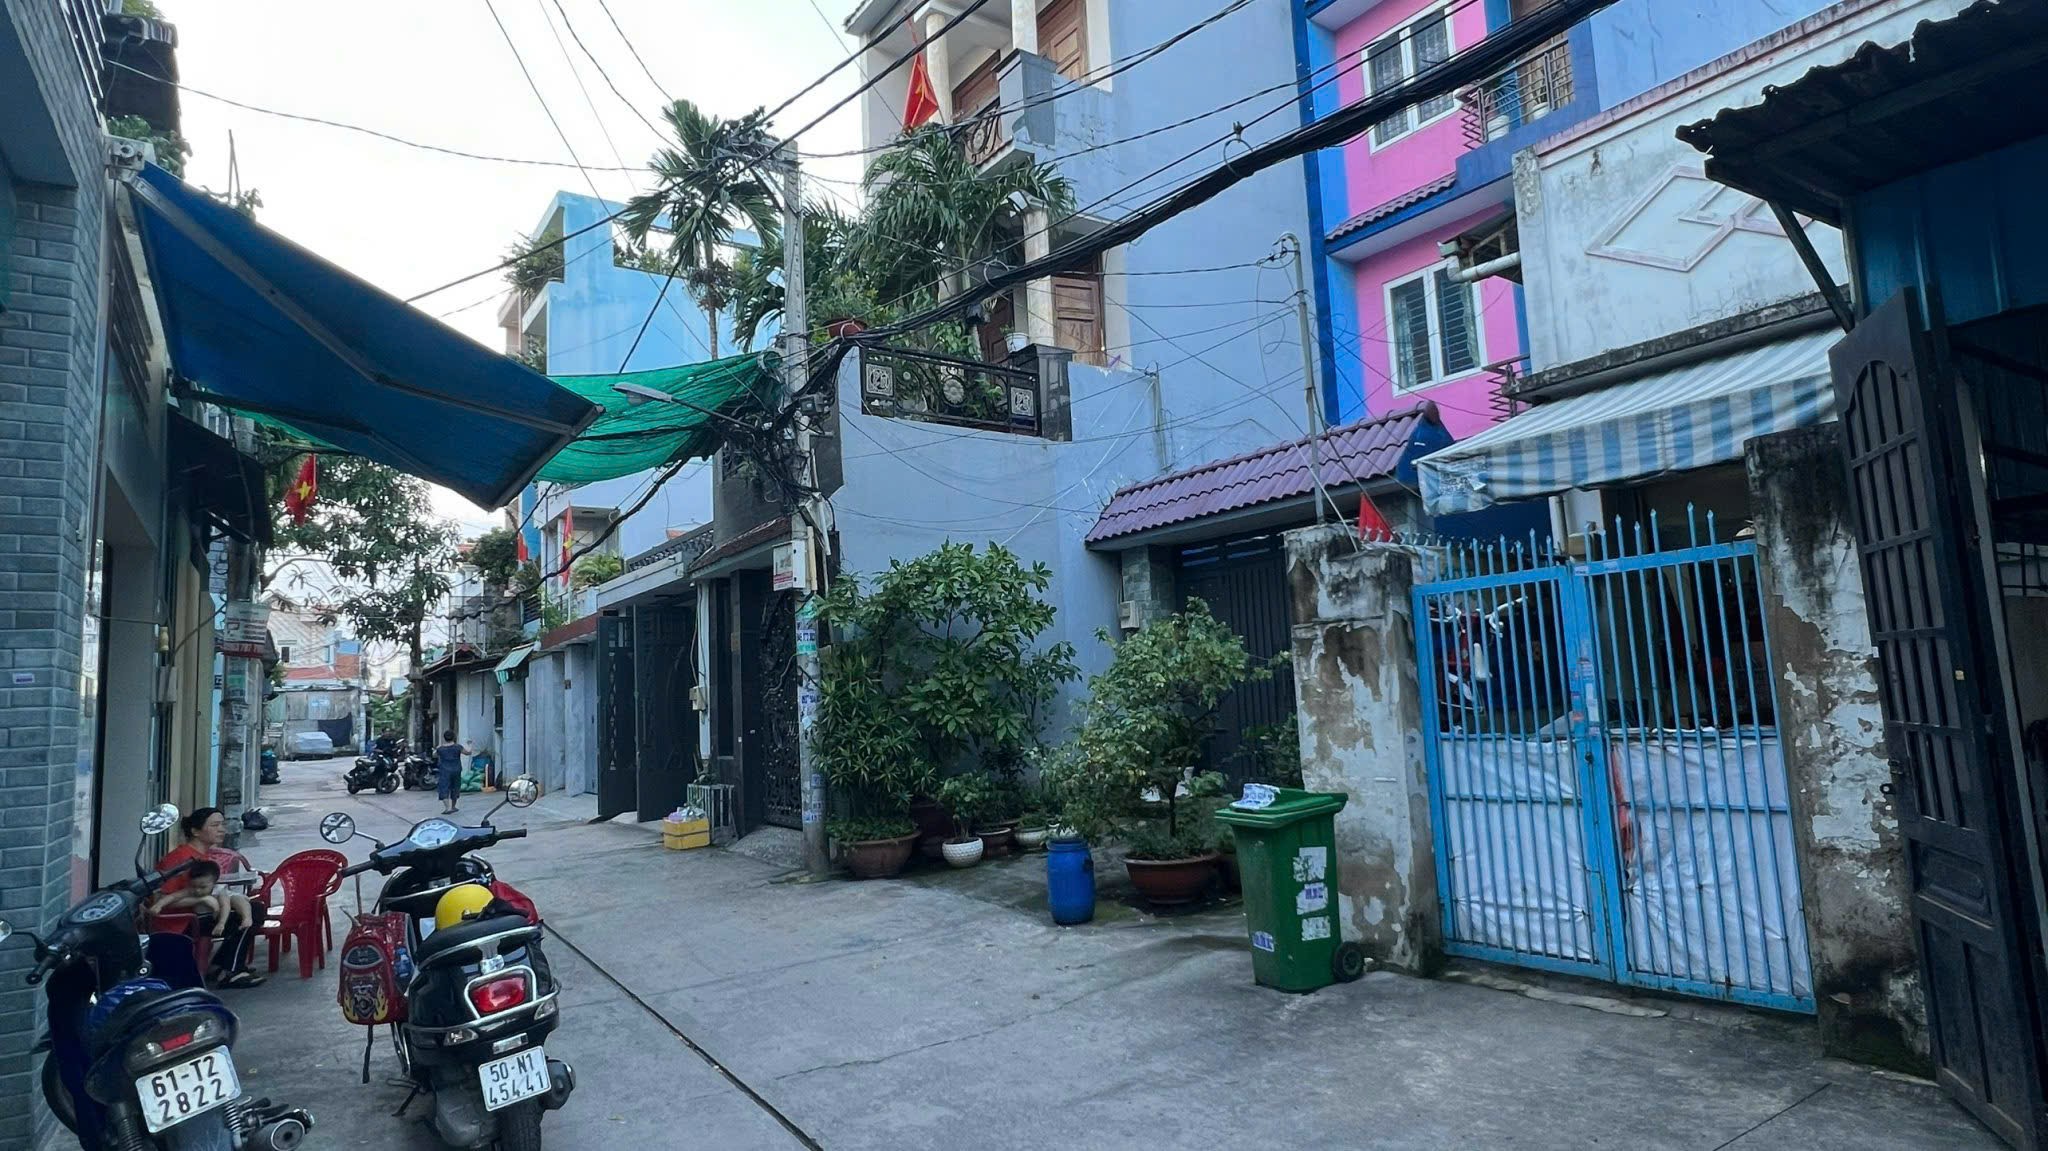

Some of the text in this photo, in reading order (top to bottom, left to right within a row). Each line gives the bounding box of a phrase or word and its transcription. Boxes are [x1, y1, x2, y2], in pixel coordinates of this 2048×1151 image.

[151, 1056, 219, 1098] 61-T2
[489, 1053, 534, 1083] 50-N1
[158, 1078, 227, 1124] 2822
[489, 1071, 544, 1105] 454.41
